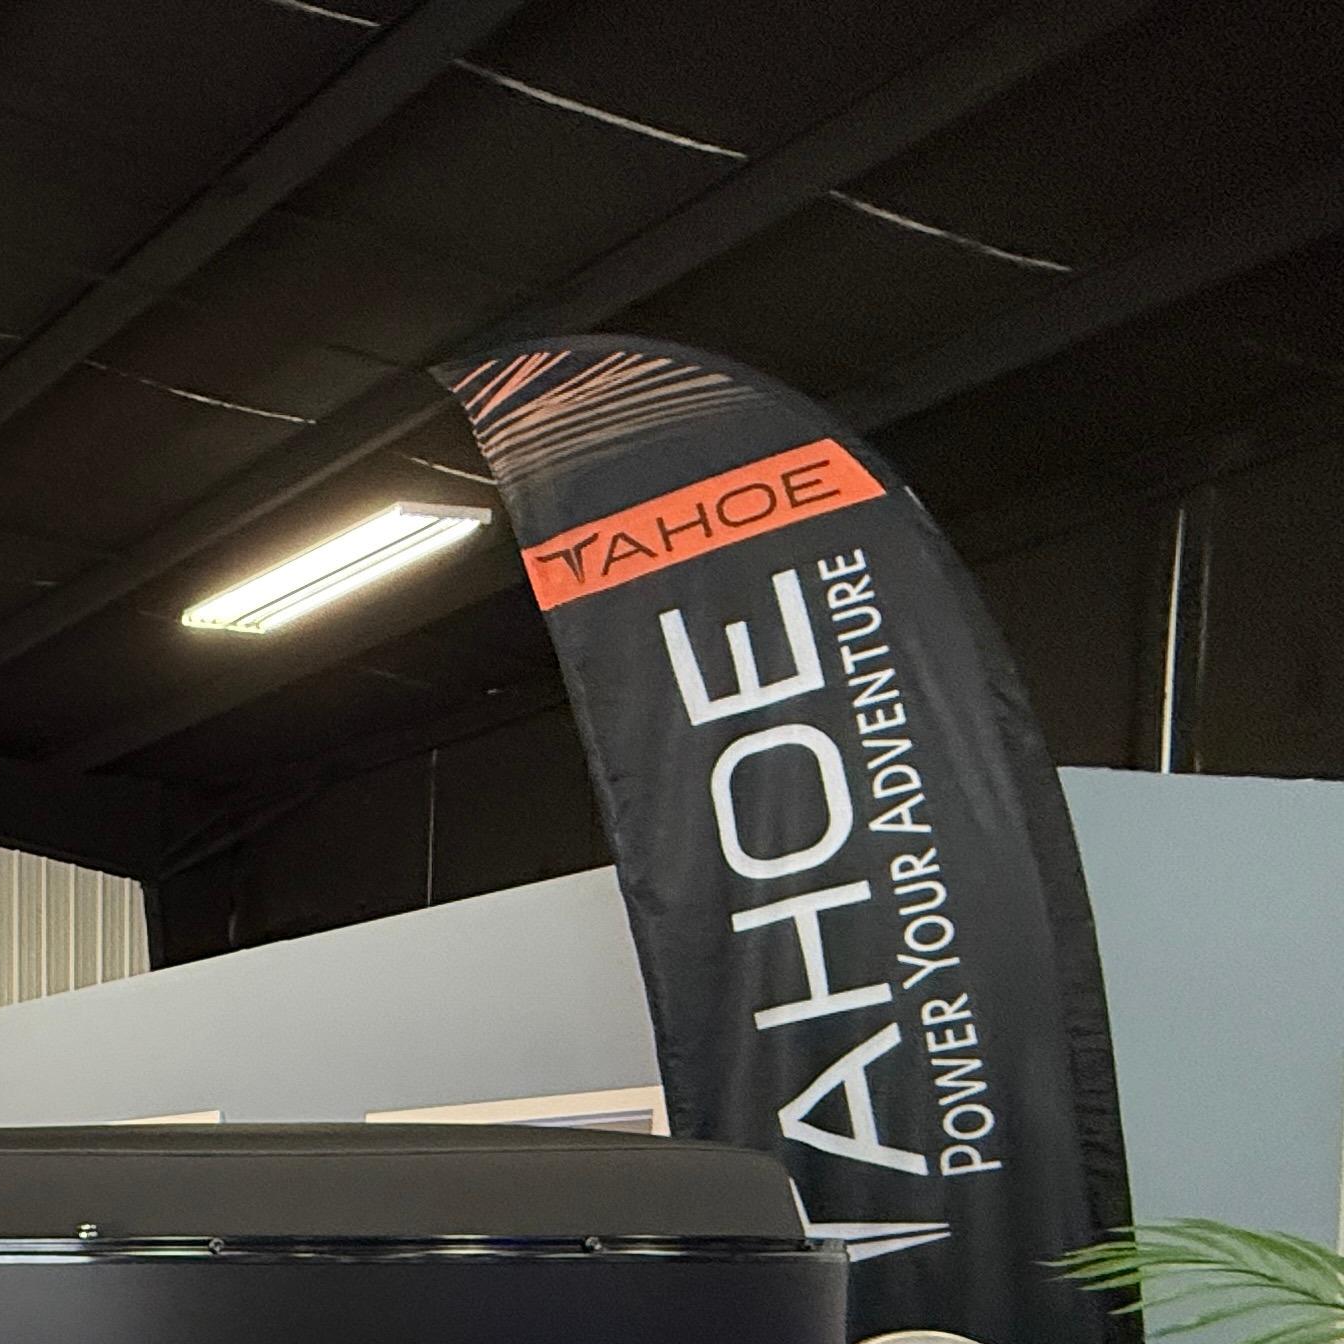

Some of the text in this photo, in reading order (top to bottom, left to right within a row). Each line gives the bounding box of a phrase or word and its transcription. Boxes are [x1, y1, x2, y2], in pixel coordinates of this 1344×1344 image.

[536, 459, 841, 584] TAHOE
[817, 548, 1003, 1177] POWER YOUR ADVENTURE
